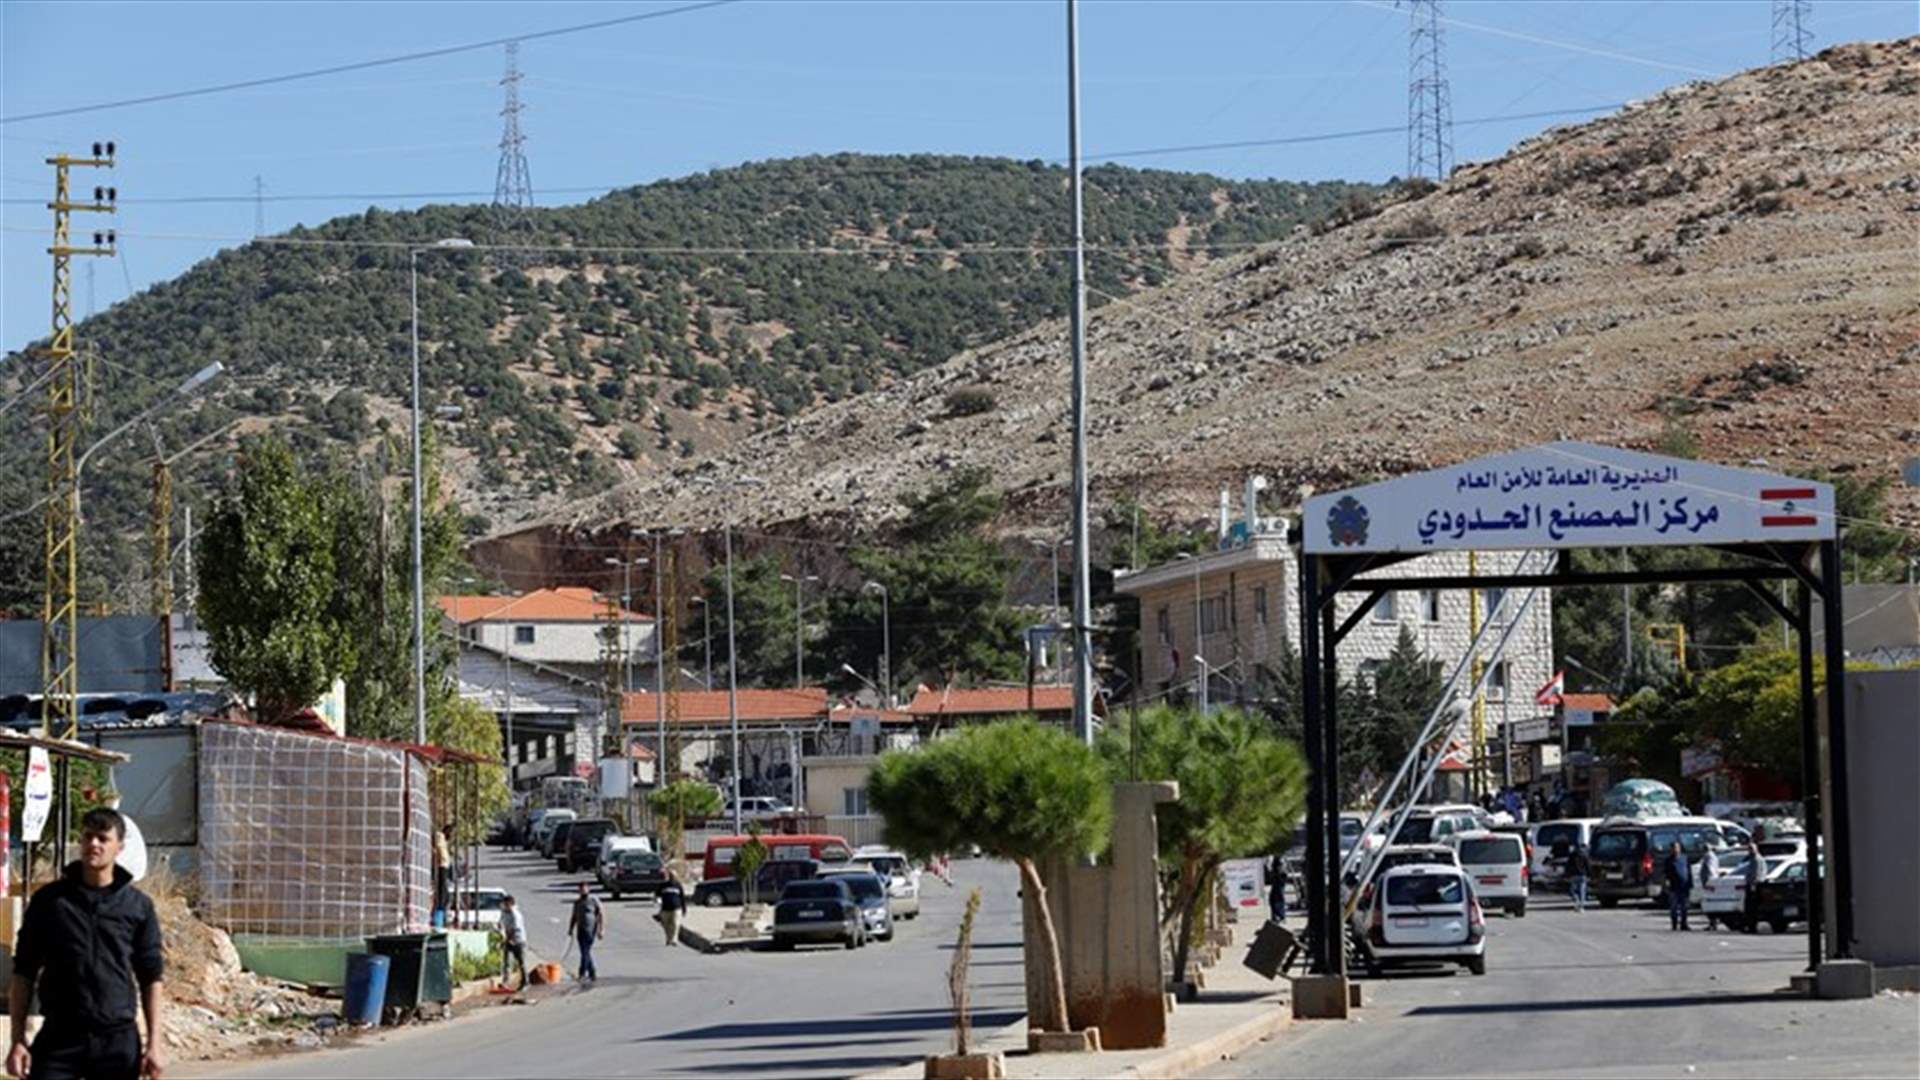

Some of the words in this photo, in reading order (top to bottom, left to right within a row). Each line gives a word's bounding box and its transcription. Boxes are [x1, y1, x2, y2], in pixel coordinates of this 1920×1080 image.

[1457, 471, 1497, 492] العام
[1501, 467, 1542, 492] للأمن
[1548, 467, 1597, 486] العامة
[1602, 465, 1678, 491] المديرية
[1418, 503, 1541, 544] الحدودي
[1549, 500, 1650, 540] المصنع
[1656, 497, 1719, 533] مركز
